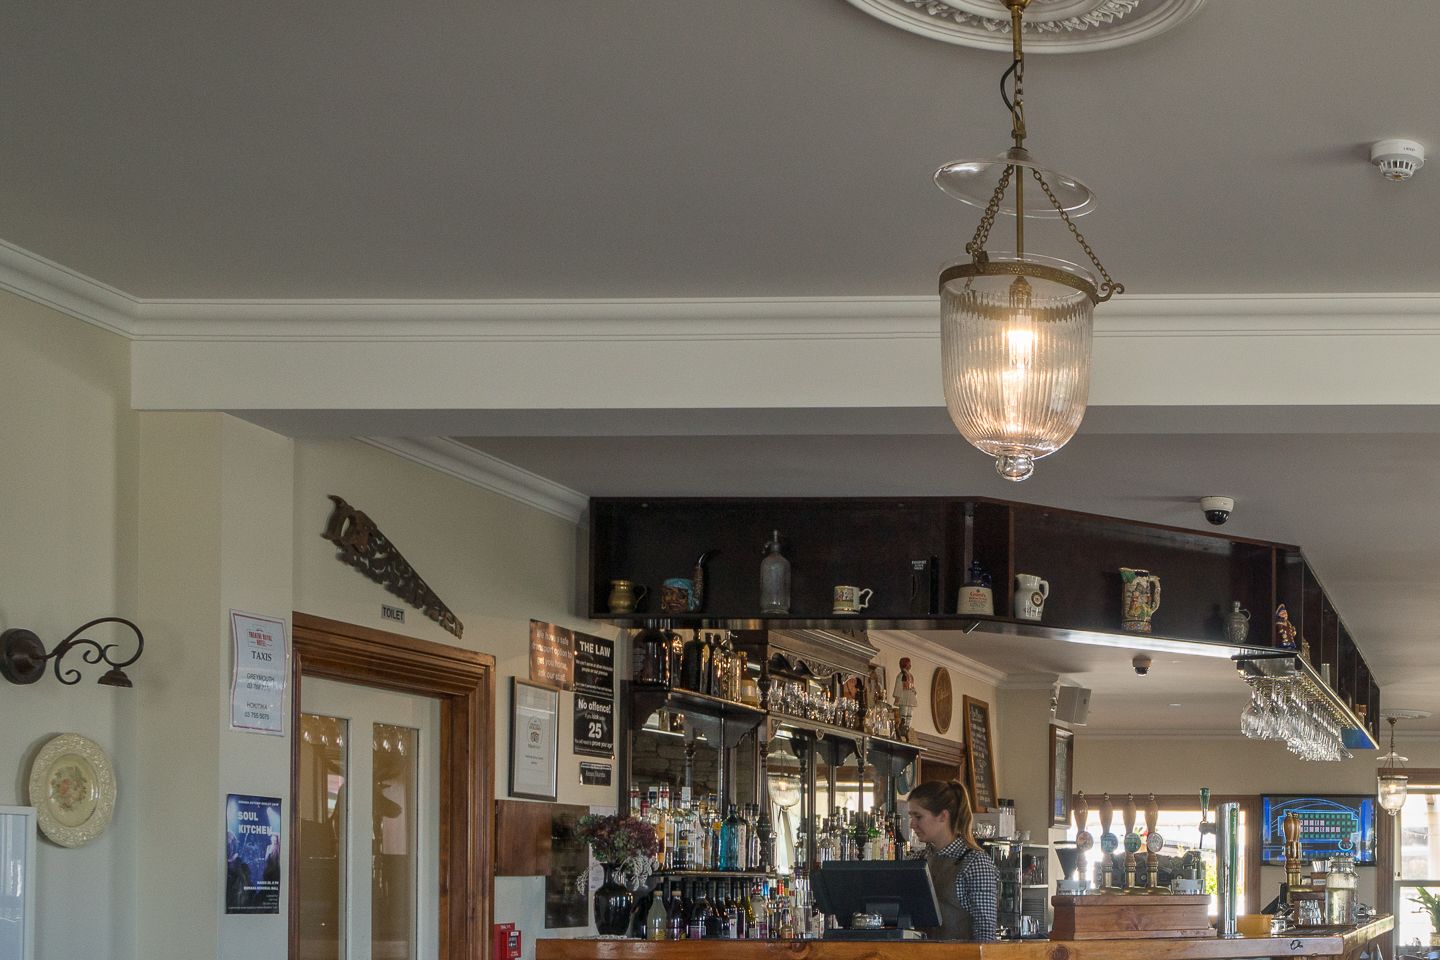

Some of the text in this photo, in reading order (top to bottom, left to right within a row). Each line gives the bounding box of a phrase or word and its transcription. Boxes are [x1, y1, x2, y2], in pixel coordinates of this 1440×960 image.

[383, 606, 404, 621] TOILET
[560, 637, 569, 645] safe
[554, 648, 567, 657] option
[579, 641, 611, 657] THE LAW
[251, 651, 272, 661] TAXIS
[247, 673, 275, 682] GREYMOUTH
[578, 698, 611, 713] No offence!
[588, 722, 602, 738] 25
[238, 811, 259, 821] SOUL
[239, 825, 273, 836] KITCHEN
